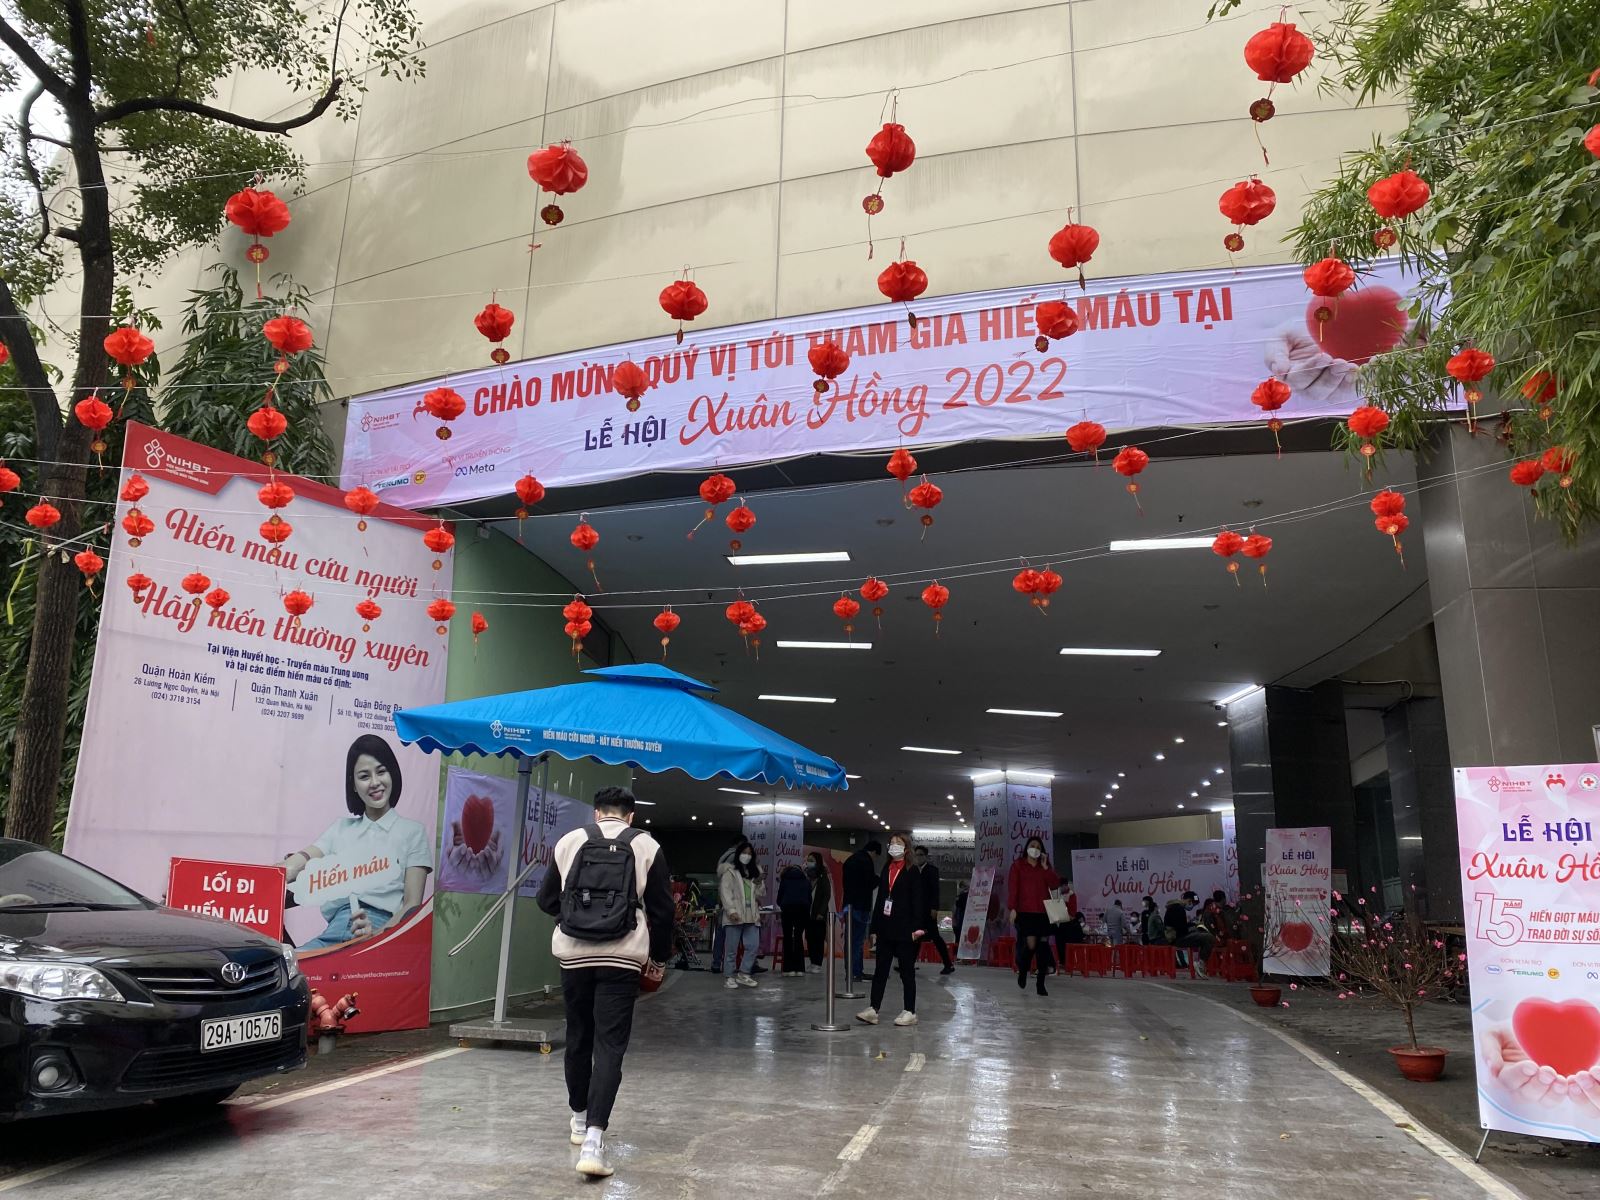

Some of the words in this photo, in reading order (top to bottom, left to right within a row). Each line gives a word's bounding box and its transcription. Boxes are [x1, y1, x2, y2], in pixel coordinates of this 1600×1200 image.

[474, 375, 541, 417] CHÀO
[551, 362, 614, 402] MỪN
[644, 343, 699, 389] QUÝ
[709, 343, 737, 383] VỊ
[747, 331, 793, 372] TỚI
[909, 313, 967, 350] GIA
[979, 293, 1035, 342] HIẾ
[1077, 287, 1160, 332] MÁU
[1172, 287, 1233, 331] TẠI
[679, 393, 797, 446] Xuân
[806, 371, 929, 437] Hồng
[942, 356, 1068, 410] 2022
[584, 417, 613, 452] LỄ
[621, 415, 667, 449] HỘI
[166, 454, 212, 474] NIHBT
[469, 463, 495, 475] Meta
[165, 508, 236, 554] Hiến
[241, 539, 299, 571] máu
[305, 557, 350, 583] cứu
[355, 569, 418, 598] người
[134, 581, 201, 633] Hãy
[273, 614, 357, 664] thường
[363, 640, 430, 672] xuyên
[142, 663, 165, 678] Quận
[168, 667, 191, 681] Hoàn
[207, 643, 220, 656] Tại
[222, 645, 240, 657] Viện
[241, 650, 264, 662] Huyết
[265, 654, 280, 665] học
[331, 666, 351, 679] Trung
[237, 661, 248, 673] tại
[249, 663, 264, 675] các
[251, 682, 271, 695] Quận
[274, 685, 297, 699] Thanh
[503, 727, 532, 735] NIHBT
[1502, 814, 1534, 842] LỄ
[1542, 817, 1593, 846] HỘI
[308, 863, 348, 894] Hiến
[352, 855, 390, 880] máu
[1116, 856, 1128, 871] LỄ
[1131, 857, 1149, 873] HỘI
[1268, 864, 1297, 876] Xuân
[1466, 852, 1548, 881] Xuân
[1555, 852, 1600, 884] Hồ
[203, 870, 231, 893] LỐI
[237, 878, 255, 894] ĐI
[1102, 873, 1143, 897] Xuân
[229, 904, 269, 925] MÁU
[1474, 892, 1524, 947] 15
[1529, 908, 1552, 923] HIẾN
[1554, 912, 1576, 925] GIỌT
[1577, 910, 1600, 924] MÁU
[1527, 928, 1551, 940] TRAO
[1553, 928, 1570, 940] ĐỜI
[1571, 930, 1585, 944] SỰ
[1586, 928, 1600, 941] SỐ
[1512, 969, 1544, 977] TERUMO
[205, 1015, 280, 1048] 29A-105.76
